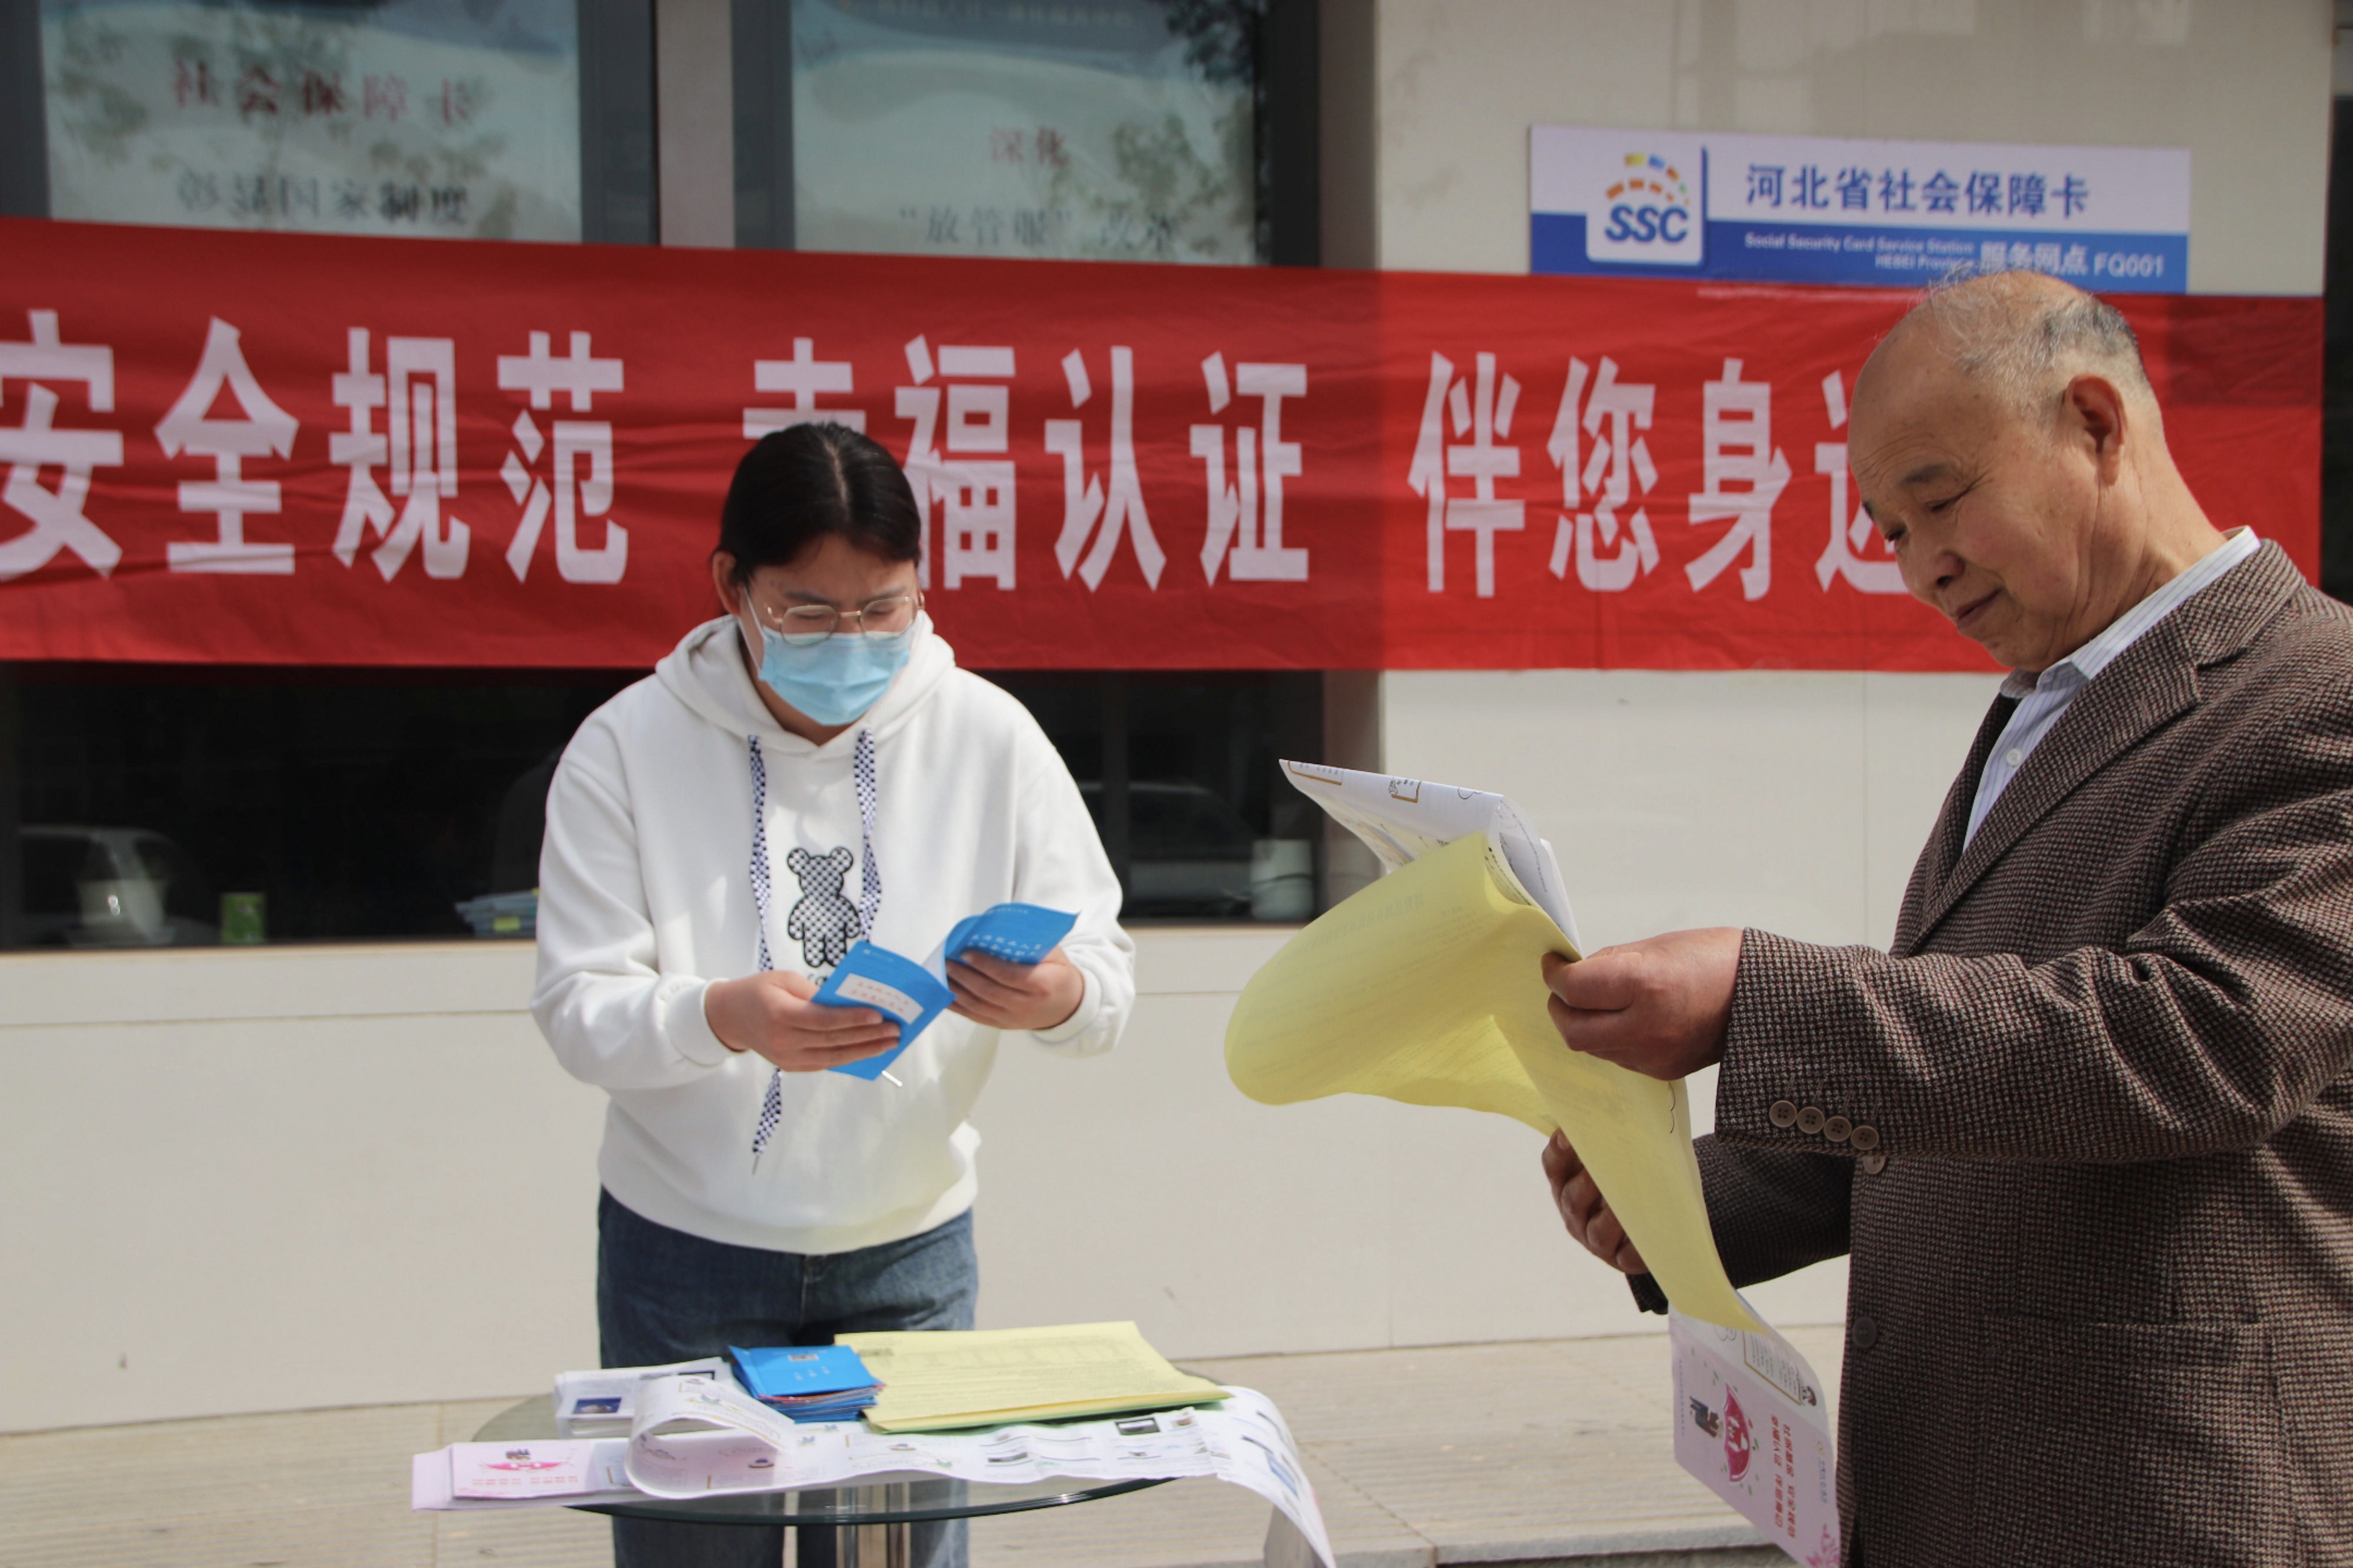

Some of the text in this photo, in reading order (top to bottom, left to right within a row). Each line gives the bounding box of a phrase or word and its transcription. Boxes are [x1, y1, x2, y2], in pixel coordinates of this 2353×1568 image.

[1746, 163, 2089, 220] 河北省社会保障卡
[1605, 203, 1689, 244] SSC
[1744, 231, 1786, 249] Social
[1787, 232, 1842, 253] Security
[1843, 234, 1875, 252] Card
[1877, 236, 1924, 254] Service
[1980, 242, 2165, 278] 服务网点 FQ001
[0, 309, 628, 584] 安全规范
